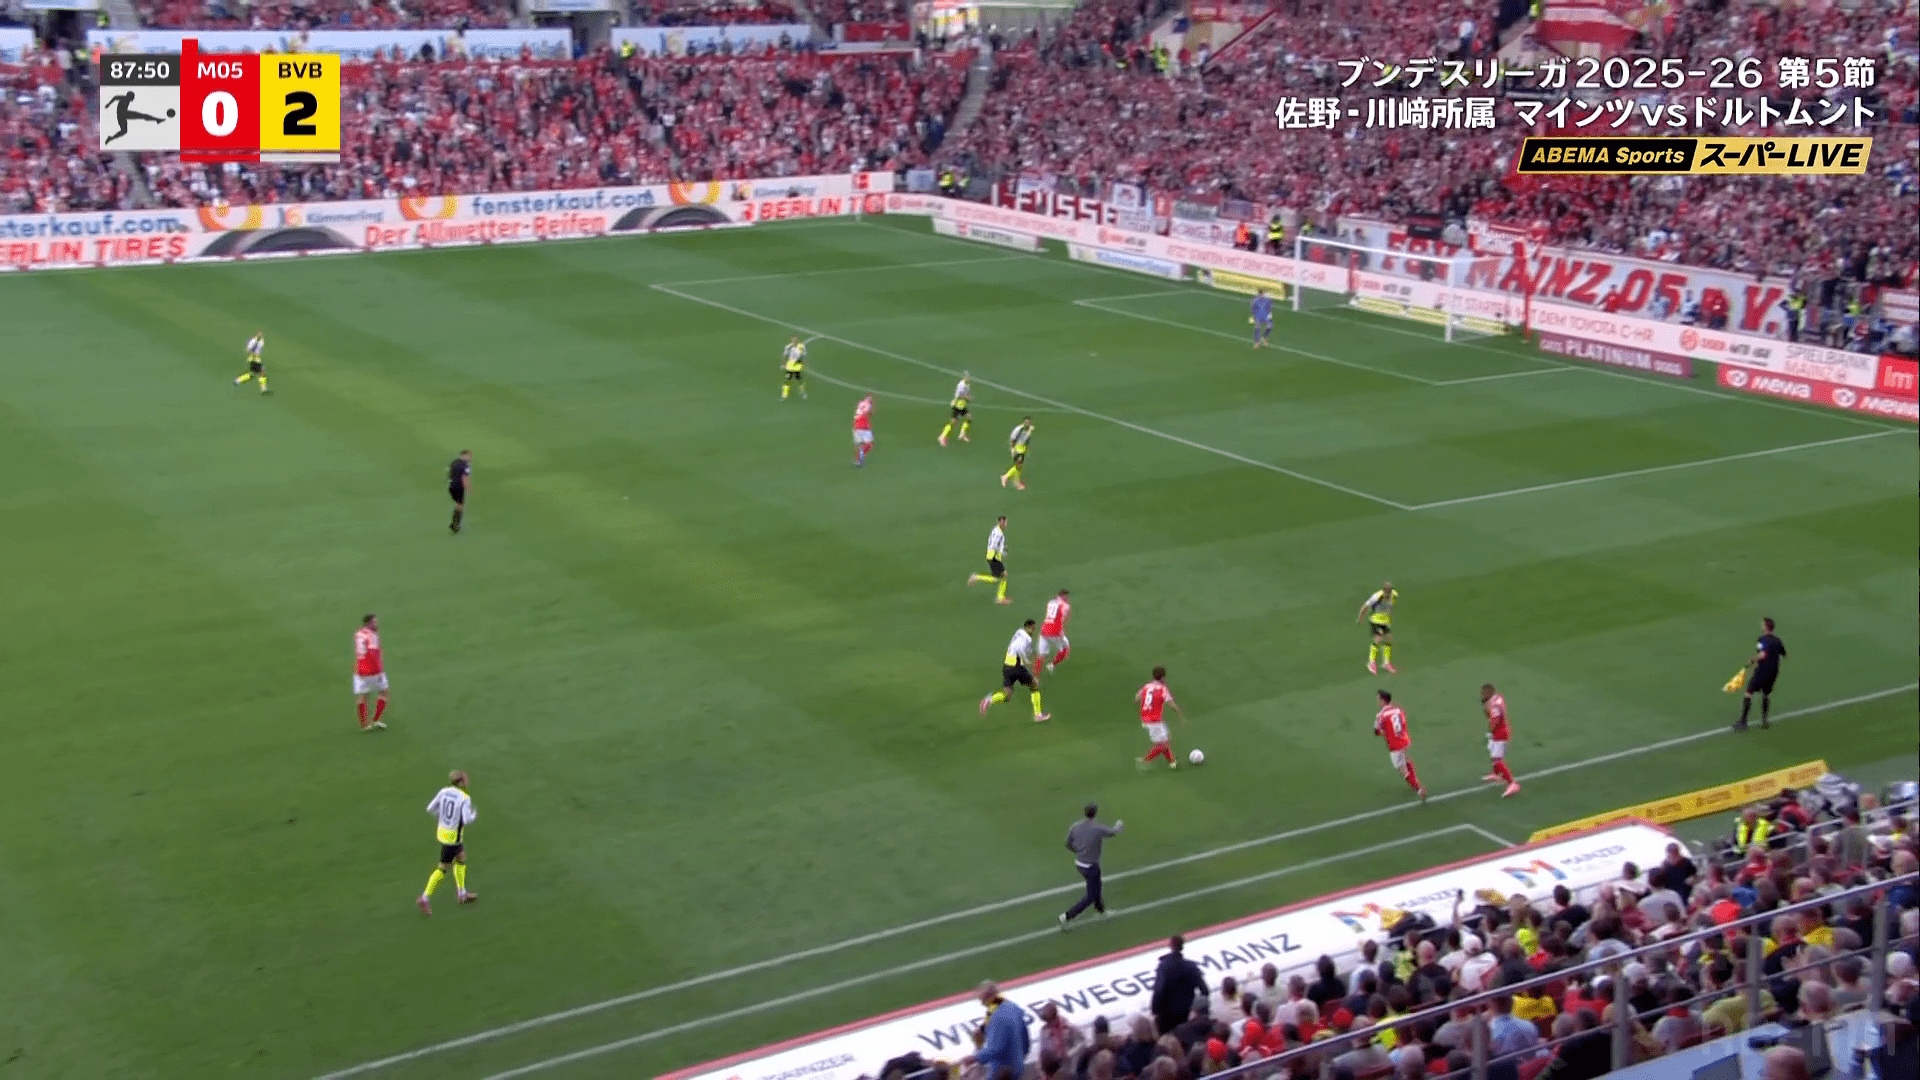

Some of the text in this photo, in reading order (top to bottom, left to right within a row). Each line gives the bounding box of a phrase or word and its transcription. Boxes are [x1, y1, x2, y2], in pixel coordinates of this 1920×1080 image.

[759, 199, 842, 220] BERLIN
[94, 234, 187, 260] TIRES
[366, 225, 407, 247] Der
[442, 797, 455, 821] 10
